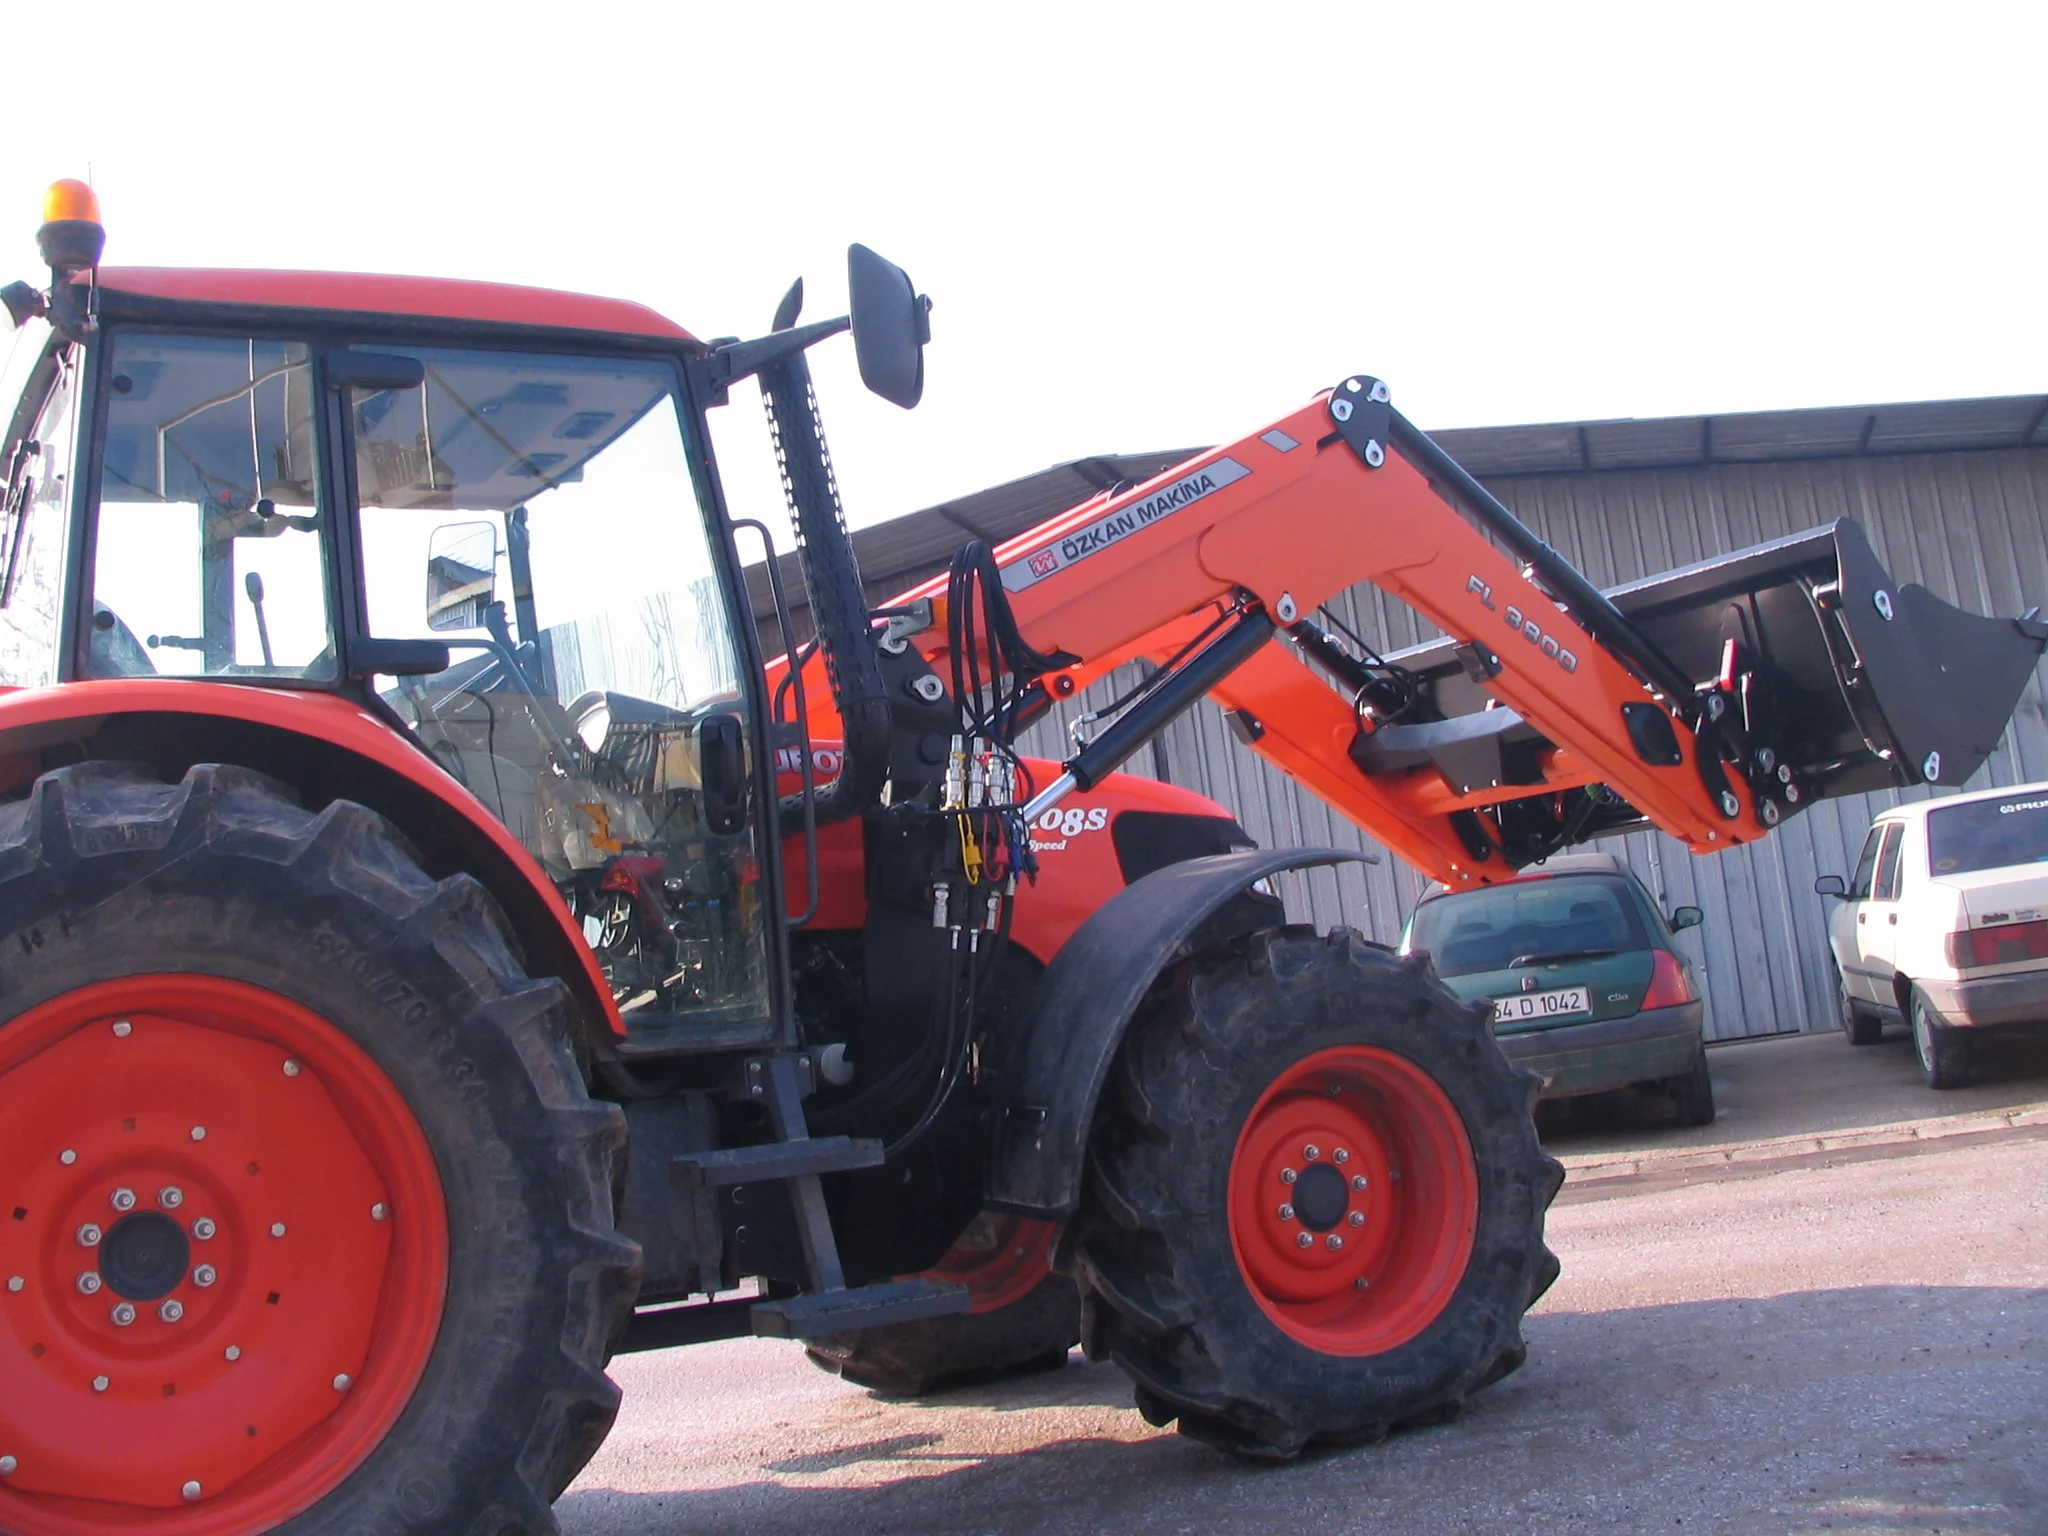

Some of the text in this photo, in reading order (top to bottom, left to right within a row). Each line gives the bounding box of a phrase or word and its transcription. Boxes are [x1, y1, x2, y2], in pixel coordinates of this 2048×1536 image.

[1061, 474, 1217, 562] ÖZKAN MAKİNA
[1466, 573, 1578, 674] FL 3800
[1520, 998, 1534, 1016] D
[1540, 992, 1581, 1014] 1042
